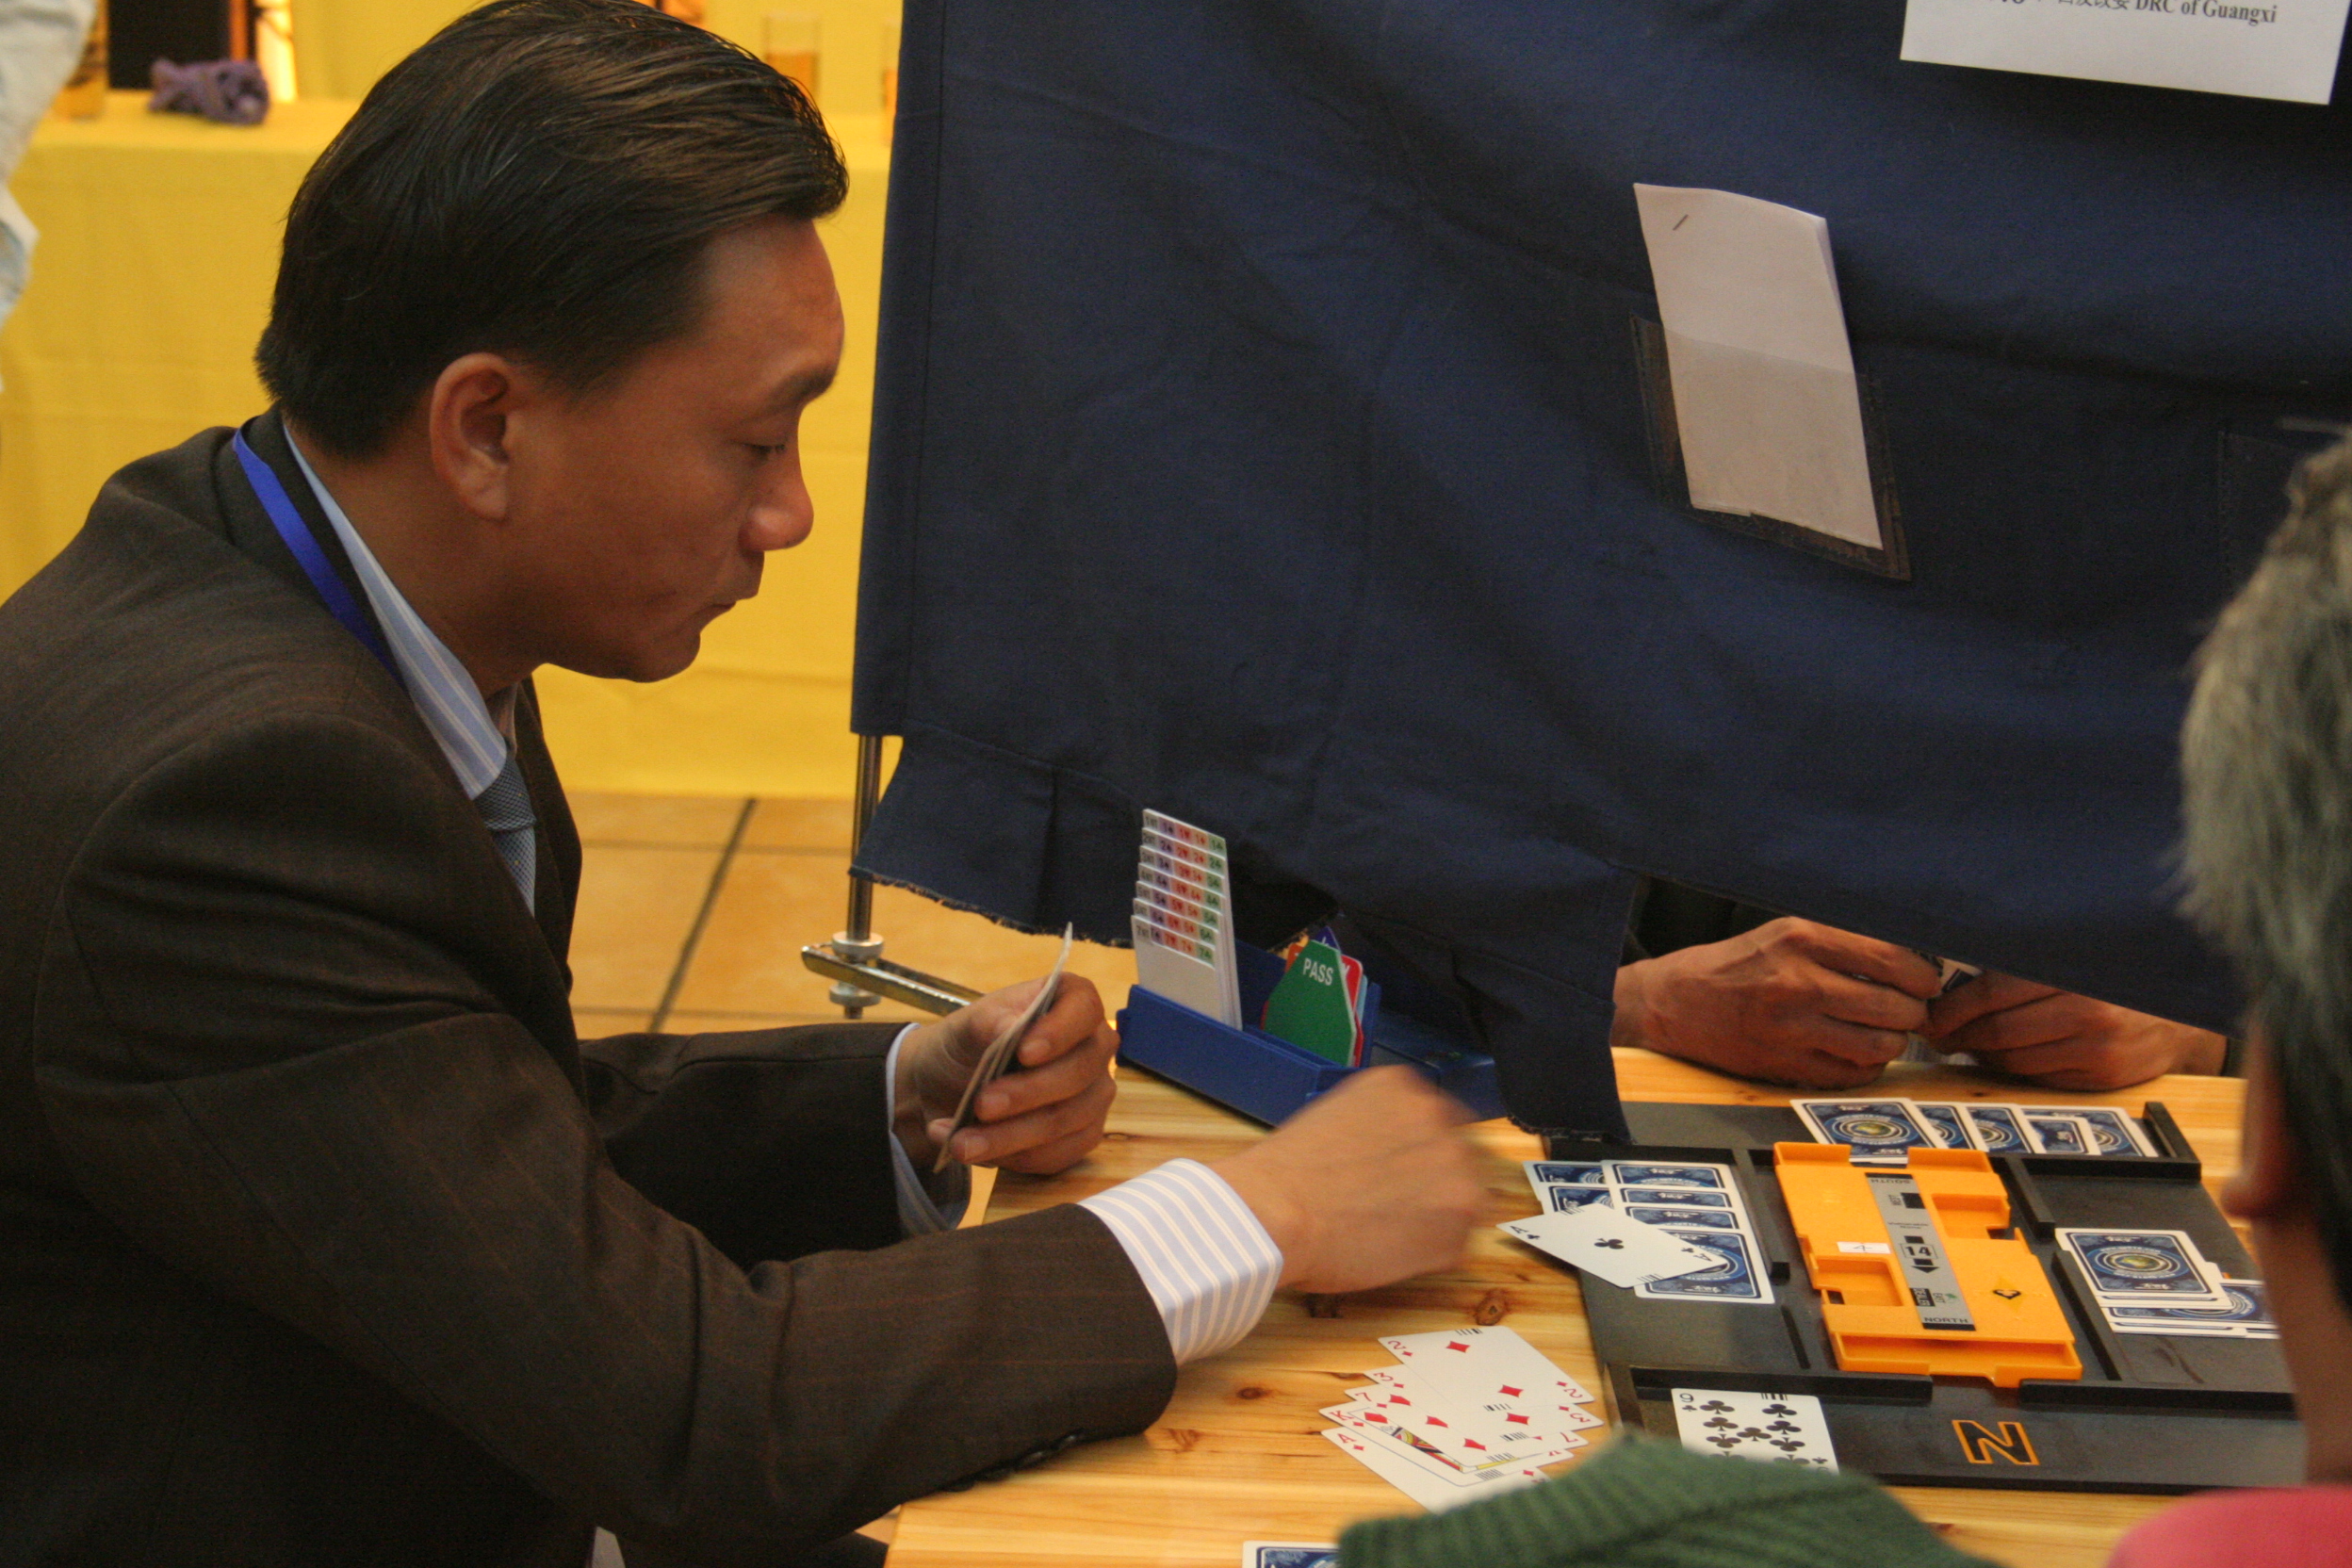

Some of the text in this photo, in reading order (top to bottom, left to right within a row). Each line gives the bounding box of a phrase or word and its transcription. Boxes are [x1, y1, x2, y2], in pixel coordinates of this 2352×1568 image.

[2135, 0, 2278, 26] DRC of Guangxi
[1302, 957, 1334, 986] PASS
[1510, 1225, 1528, 1234] A
[1905, 1246, 1932, 1257] 14
[1693, 1253, 1712, 1262] A
[1388, 1340, 1407, 1350] 2
[1373, 1372, 1394, 1382] 3
[1355, 1392, 1372, 1402] 7
[1563, 1388, 1583, 1398] 2
[1679, 1393, 1695, 1403] 9
[1329, 1410, 1354, 1421] K
[1569, 1413, 1591, 1423] 3
[1337, 1432, 1357, 1444] A
[1560, 1431, 1579, 1443] 7
[1952, 1419, 2040, 1466] N
